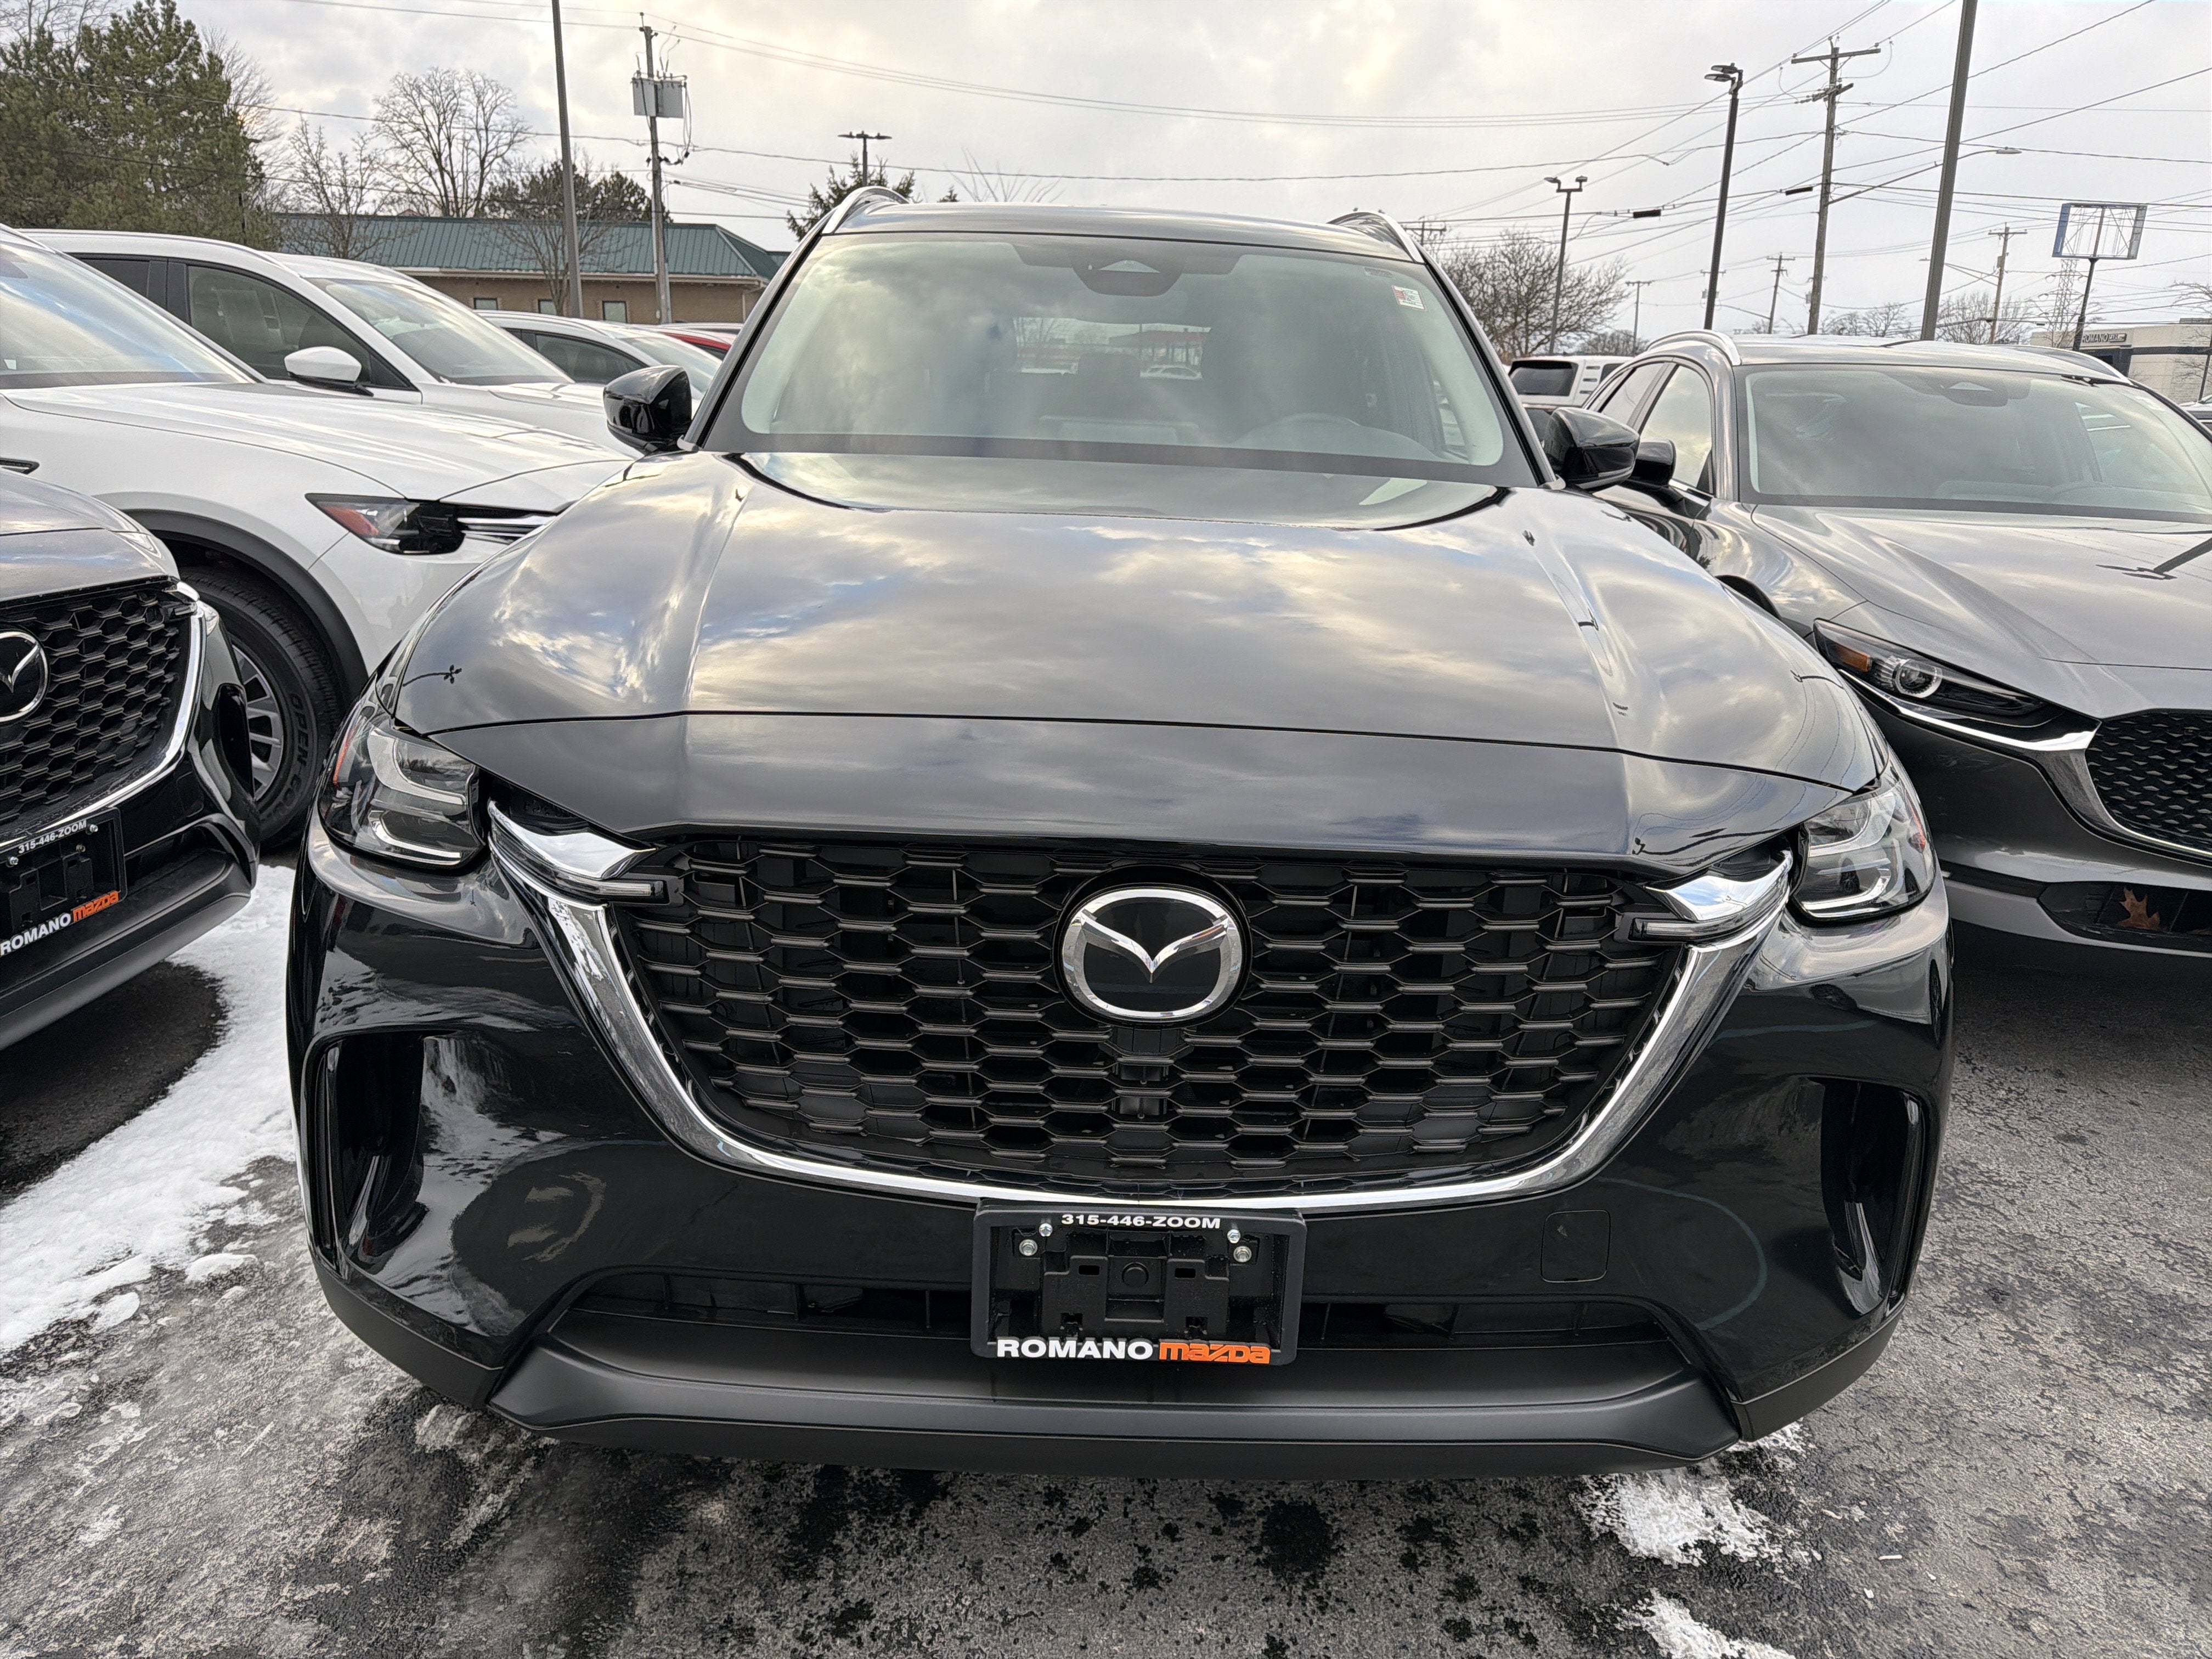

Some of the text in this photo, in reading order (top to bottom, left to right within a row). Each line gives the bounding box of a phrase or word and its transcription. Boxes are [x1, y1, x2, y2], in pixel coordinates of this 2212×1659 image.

[2082, 333, 2108, 343] ROMANO
[290, 693, 308, 766] OPEN
[18, 820, 87, 854] 315-446-ZOOM
[0, 890, 120, 955] ROMANO mazda
[1061, 1214, 1221, 1229] 315-446-ZOOM
[996, 1339, 1271, 1364] ROMANO mazda
